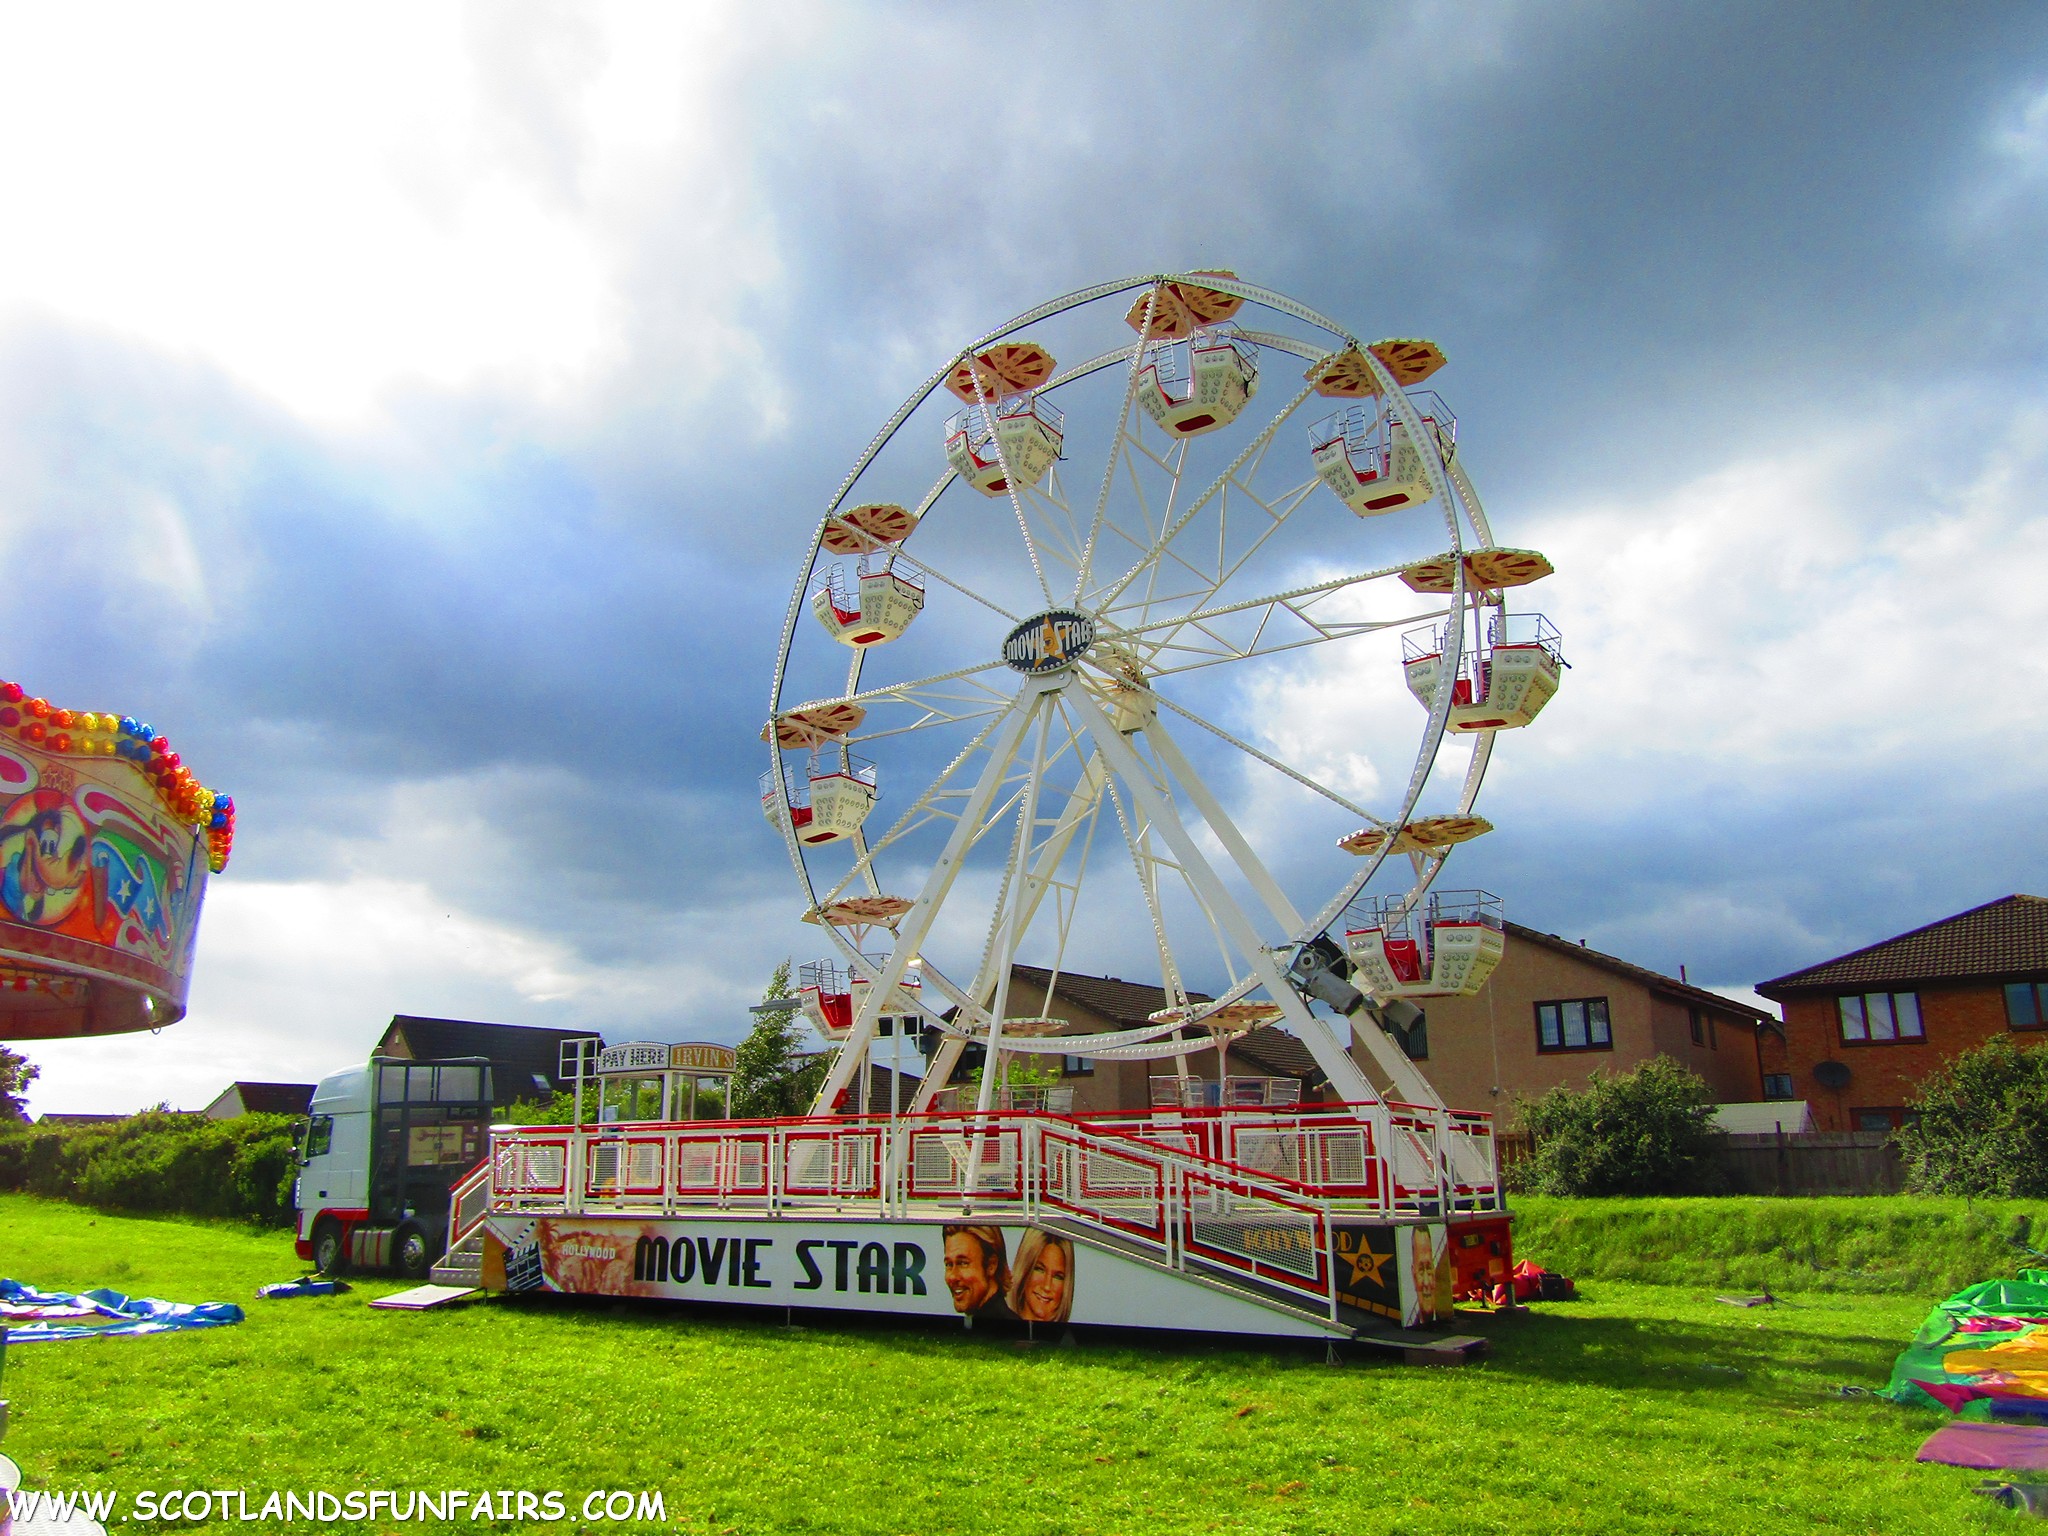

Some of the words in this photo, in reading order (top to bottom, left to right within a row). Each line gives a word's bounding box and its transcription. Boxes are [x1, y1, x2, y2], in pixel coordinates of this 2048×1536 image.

[1006, 624, 1049, 661] MOVIE
[1054, 620, 1093, 655] STAR
[602, 1049, 627, 1067] PAY
[630, 1048, 666, 1066] HERE
[675, 1047, 733, 1069] IRVIN'S
[562, 1244, 616, 1260] HOLLYWOOD
[633, 1235, 773, 1287] MOVIE
[793, 1239, 928, 1296] STAR
